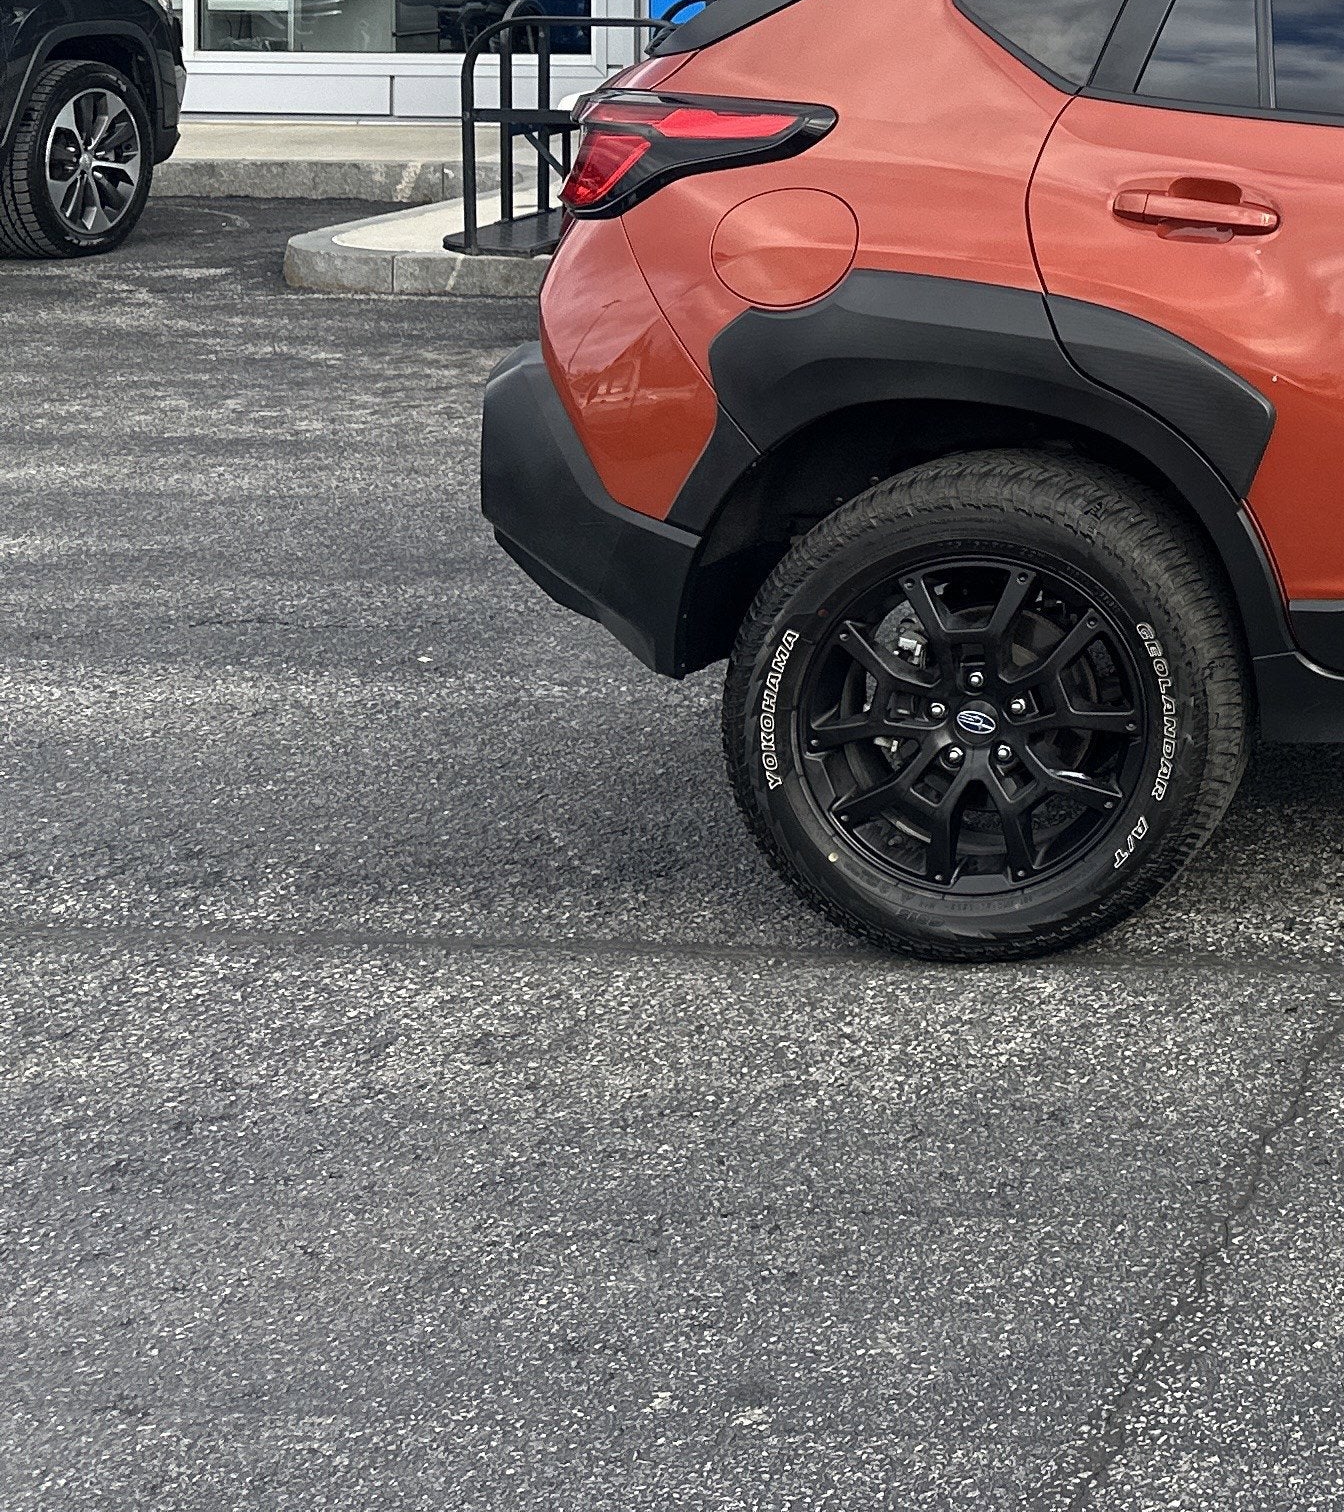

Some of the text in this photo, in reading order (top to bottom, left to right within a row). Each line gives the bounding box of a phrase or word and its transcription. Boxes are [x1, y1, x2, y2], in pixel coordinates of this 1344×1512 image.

[760, 629, 800, 790] YOKOHAMA
[1114, 622, 1176, 869] GEOLANDAR A/T
